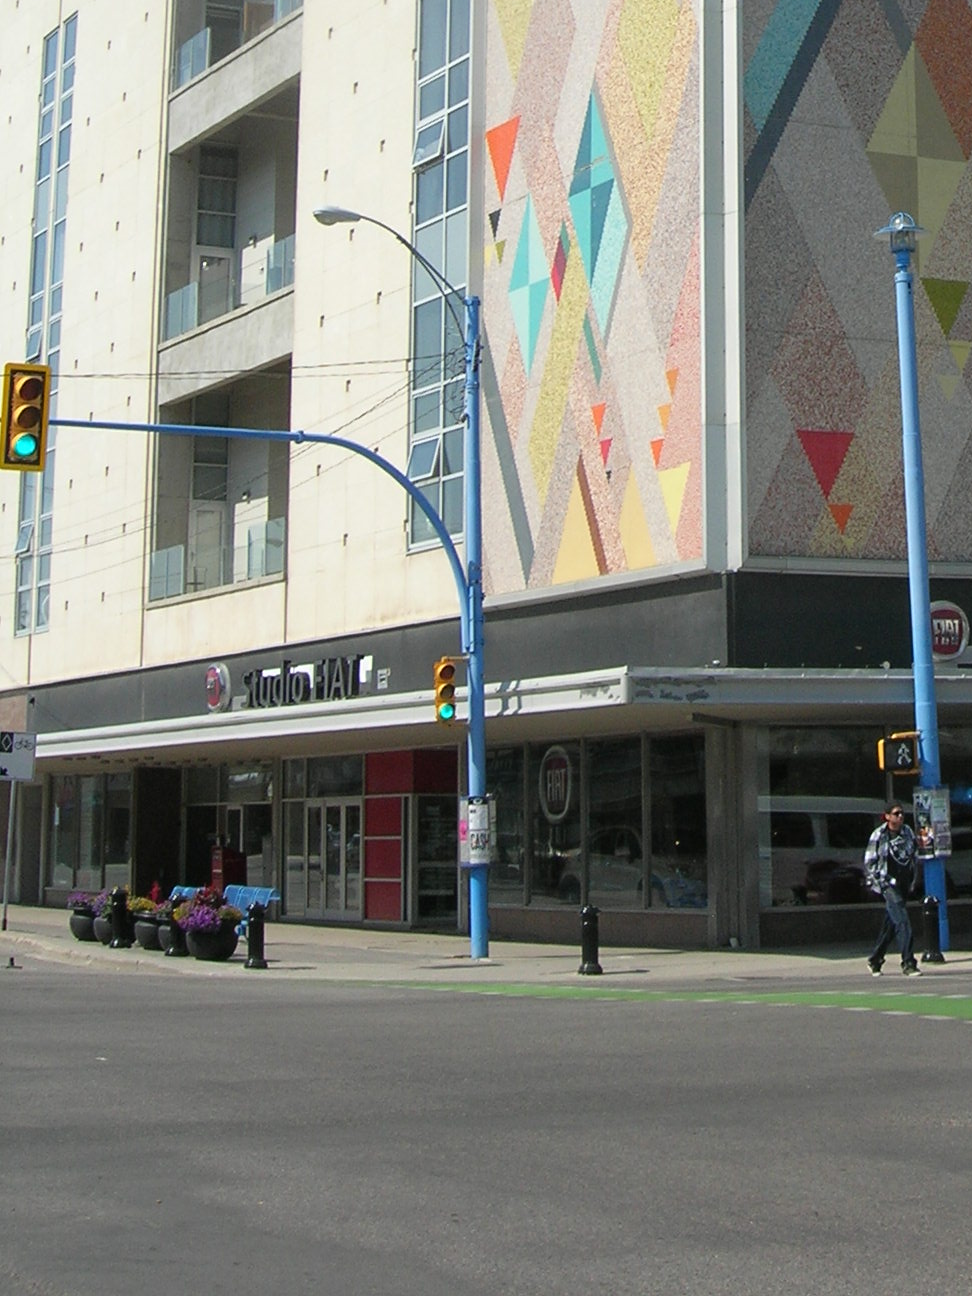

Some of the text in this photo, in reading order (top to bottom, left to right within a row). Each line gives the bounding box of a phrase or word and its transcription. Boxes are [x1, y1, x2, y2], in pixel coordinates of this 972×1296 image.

[932, 618, 959, 645] FIAT
[241, 655, 365, 709] Studio FIAT
[546, 768, 566, 802] FIAT
